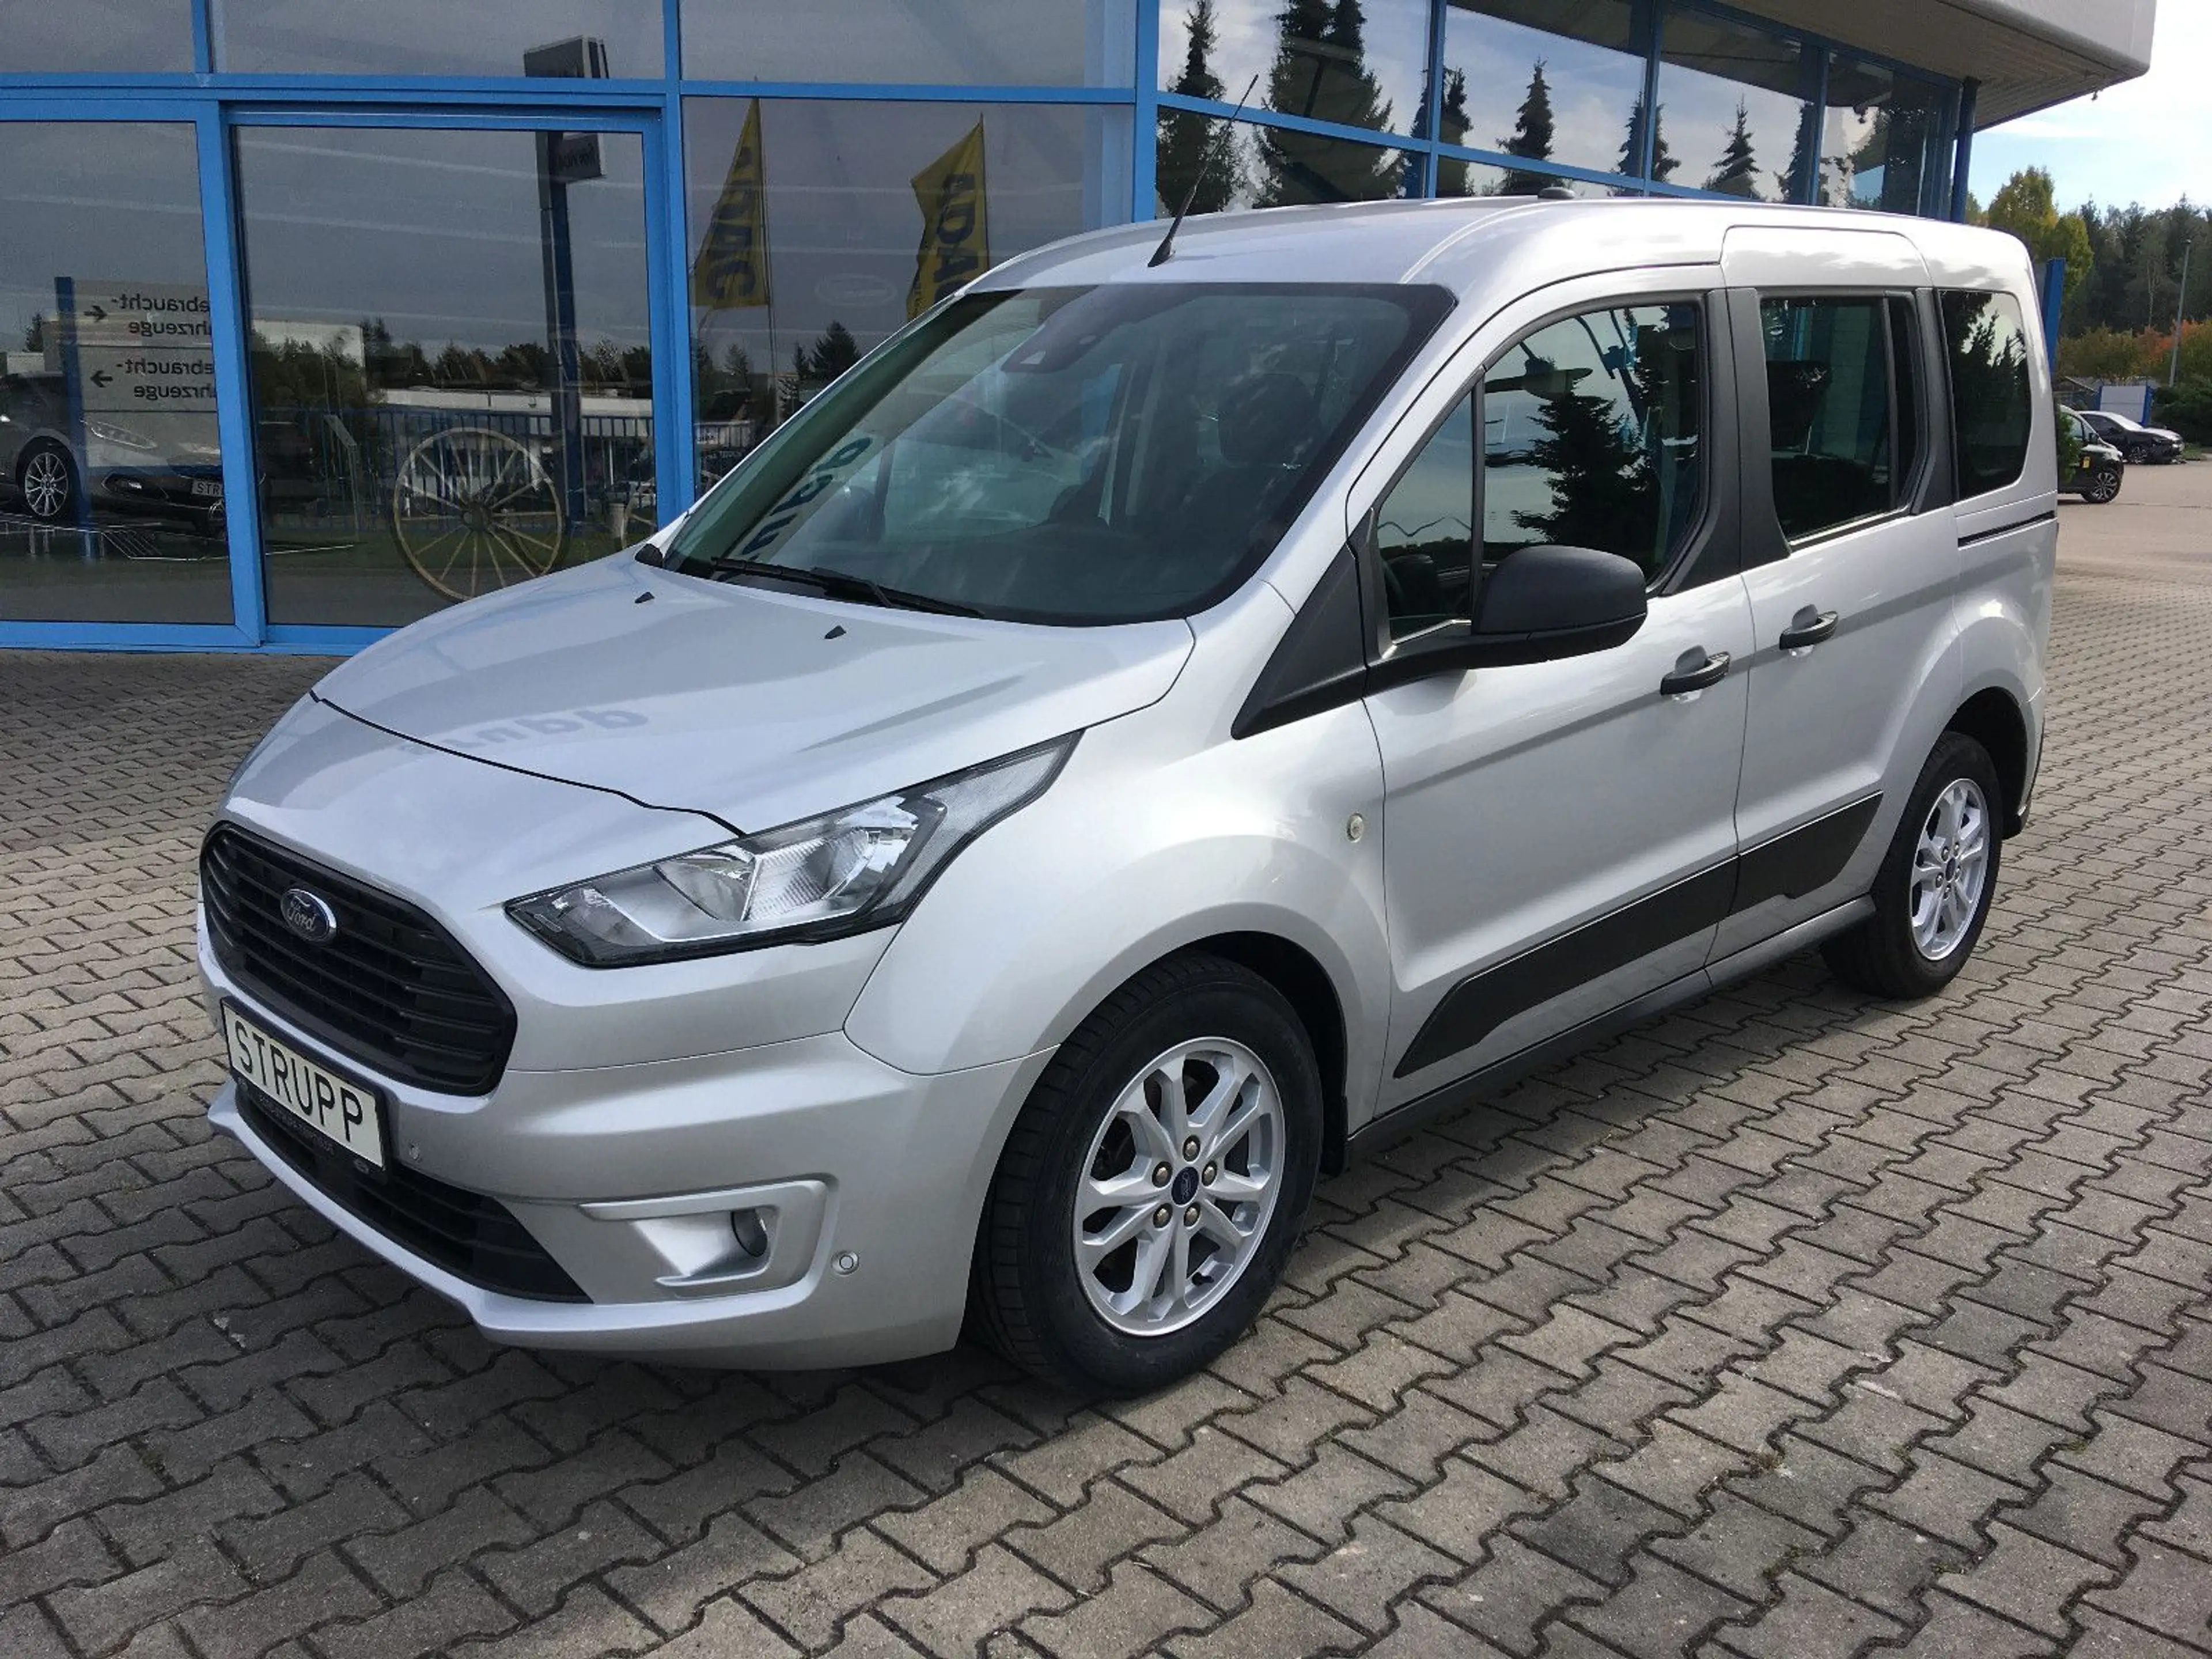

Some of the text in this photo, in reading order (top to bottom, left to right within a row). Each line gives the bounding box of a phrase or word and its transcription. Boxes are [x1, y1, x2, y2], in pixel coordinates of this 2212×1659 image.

[196, 482, 222, 495] STR
[286, 894, 318, 932] Ford
[234, 1020, 363, 1142] STRUPP
